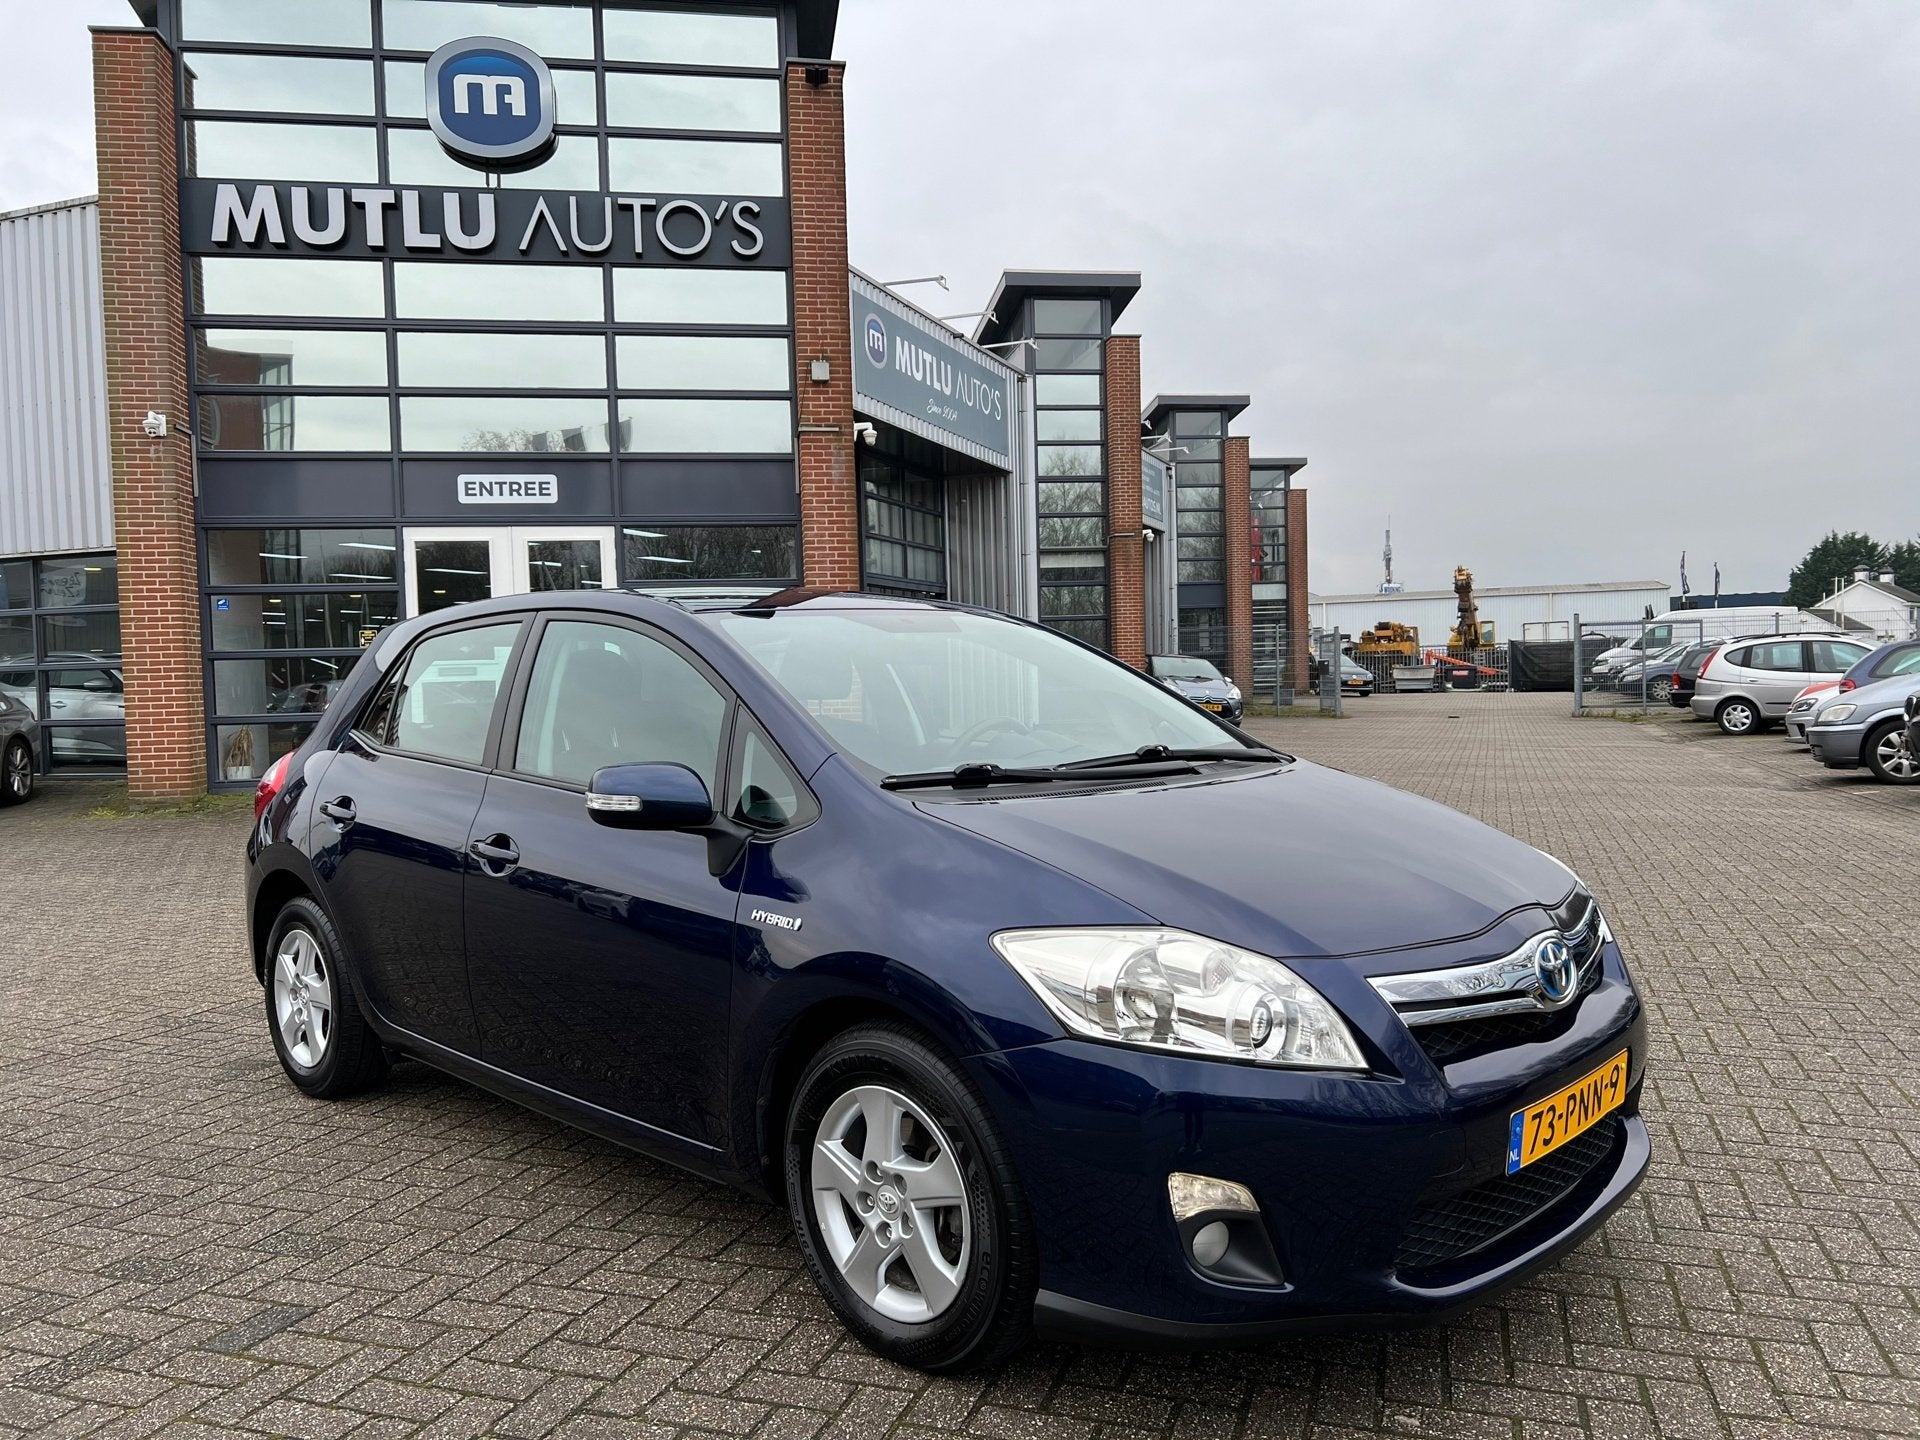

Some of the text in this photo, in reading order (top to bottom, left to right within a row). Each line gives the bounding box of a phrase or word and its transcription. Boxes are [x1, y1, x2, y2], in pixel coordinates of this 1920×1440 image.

[211, 184, 765, 257] MUTLU AUTO'S
[895, 336, 1001, 421] MUTLU AUTO'S
[464, 480, 552, 497] ENTREE
[1529, 1063, 1620, 1155] 73-PNN-9
[1509, 1148, 1520, 1163] NL
